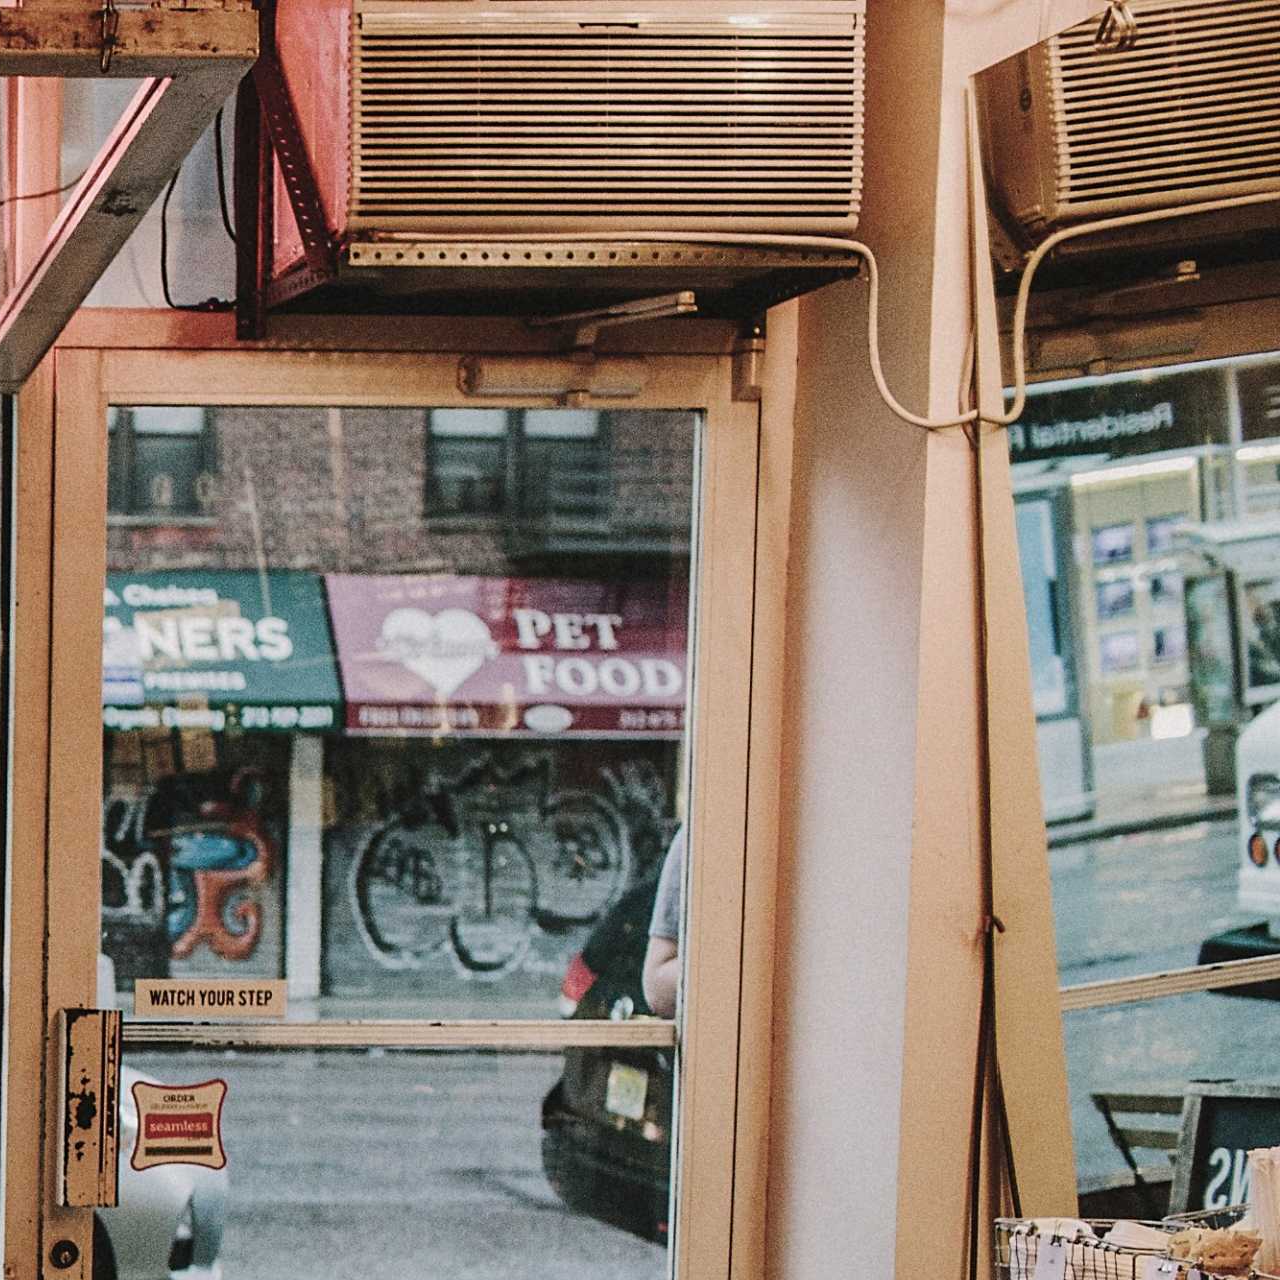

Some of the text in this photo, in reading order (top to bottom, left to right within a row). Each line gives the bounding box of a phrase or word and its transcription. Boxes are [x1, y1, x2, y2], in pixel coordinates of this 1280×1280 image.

[511, 609, 623, 651] PET
[523, 655, 684, 697] FOOD
[149, 990, 273, 1006] WATCH YOUR STEP
[149, 1119, 209, 1132] seamless
